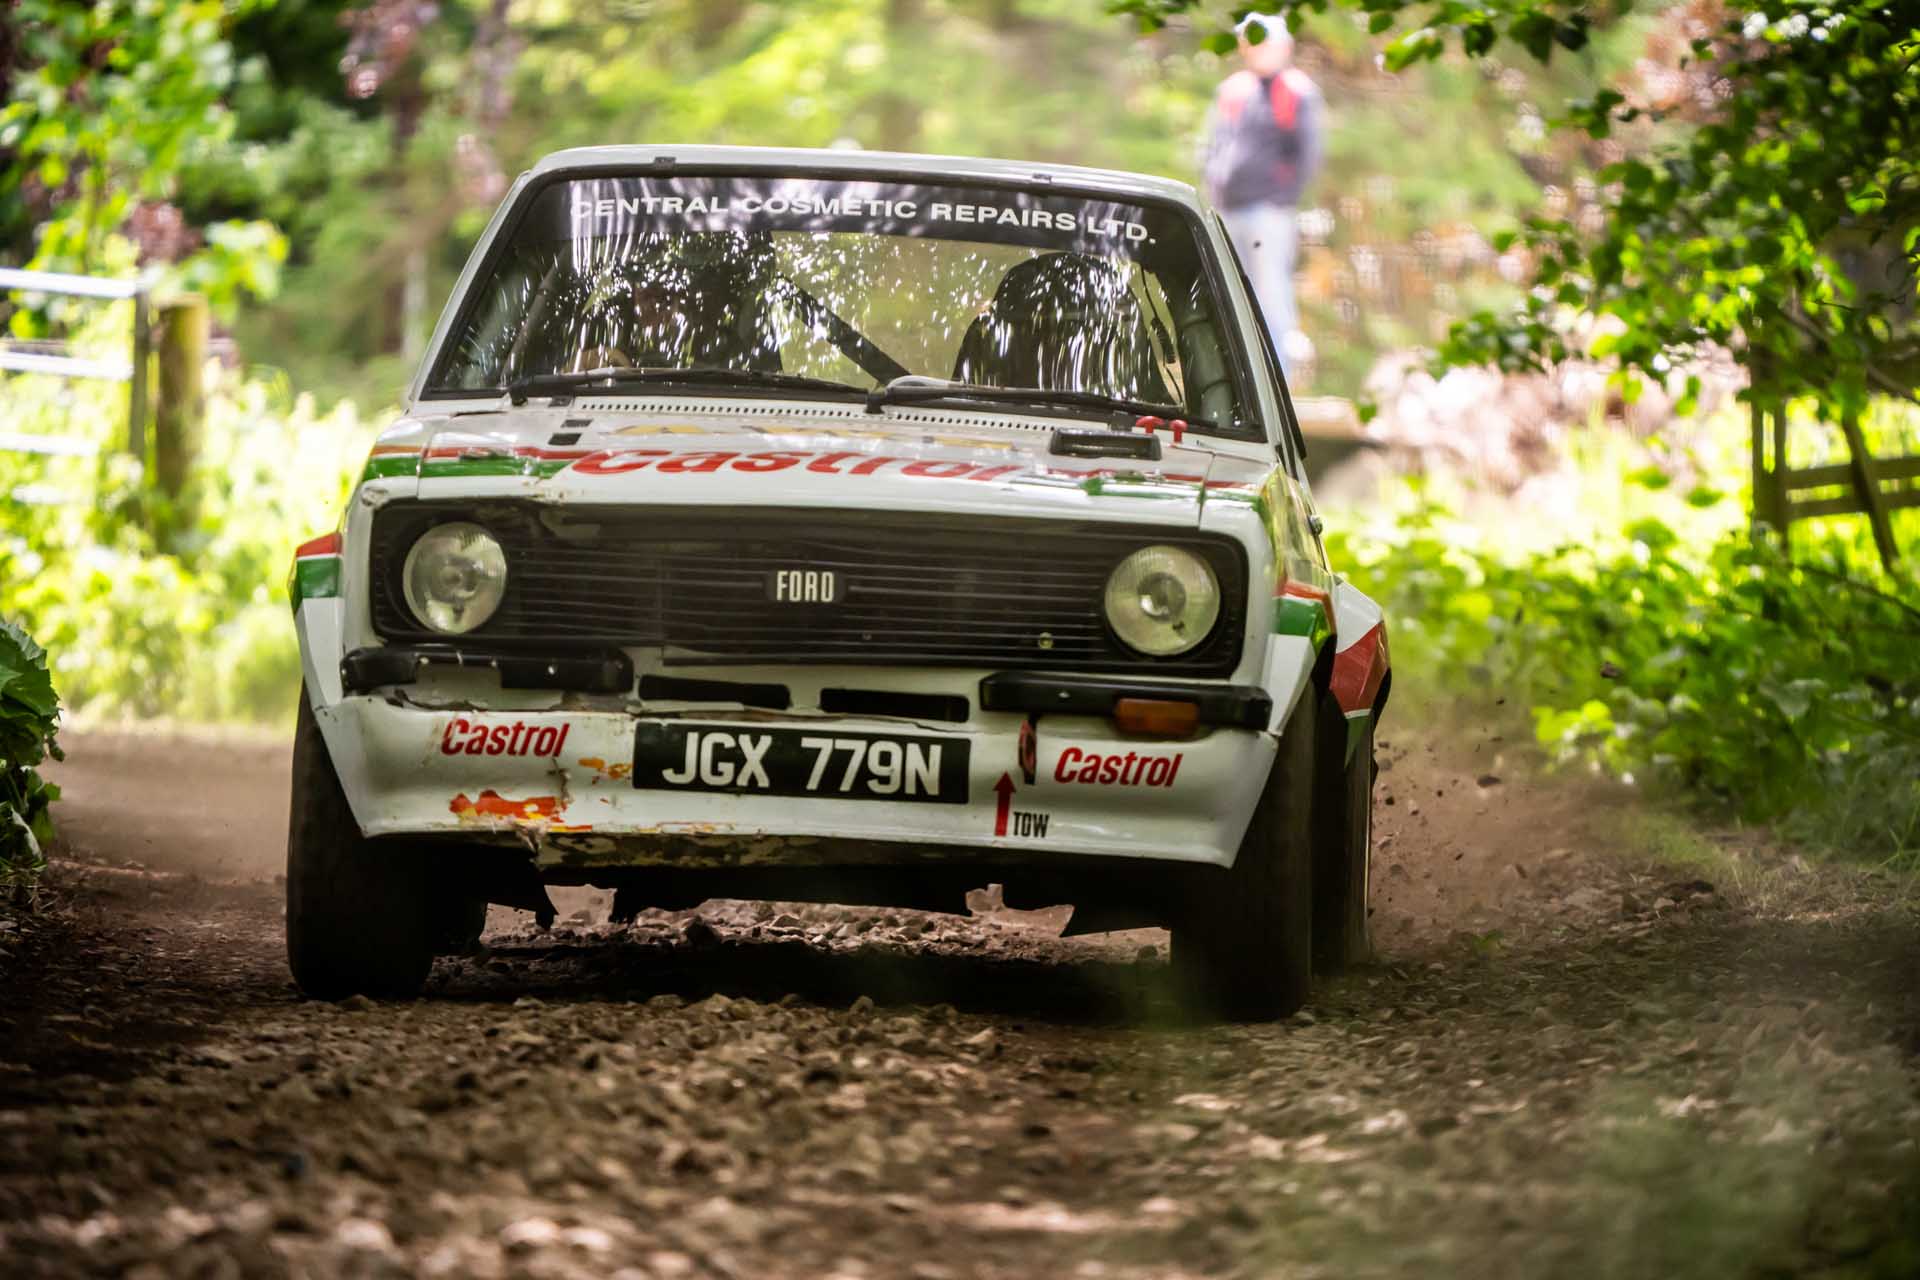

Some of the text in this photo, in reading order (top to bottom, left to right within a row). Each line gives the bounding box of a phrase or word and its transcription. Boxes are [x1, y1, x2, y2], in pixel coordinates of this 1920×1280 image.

[742, 197, 917, 219] COSMETIC
[931, 203, 1077, 231] REPAIRS
[1087, 215, 1156, 244] LTD.
[571, 448, 1023, 482] Castrol
[776, 571, 834, 602] FORD
[441, 718, 570, 758] Castrol
[662, 731, 942, 797] JGX 779N
[1053, 747, 1184, 788] Castrol
[1013, 811, 1050, 838] TOW
